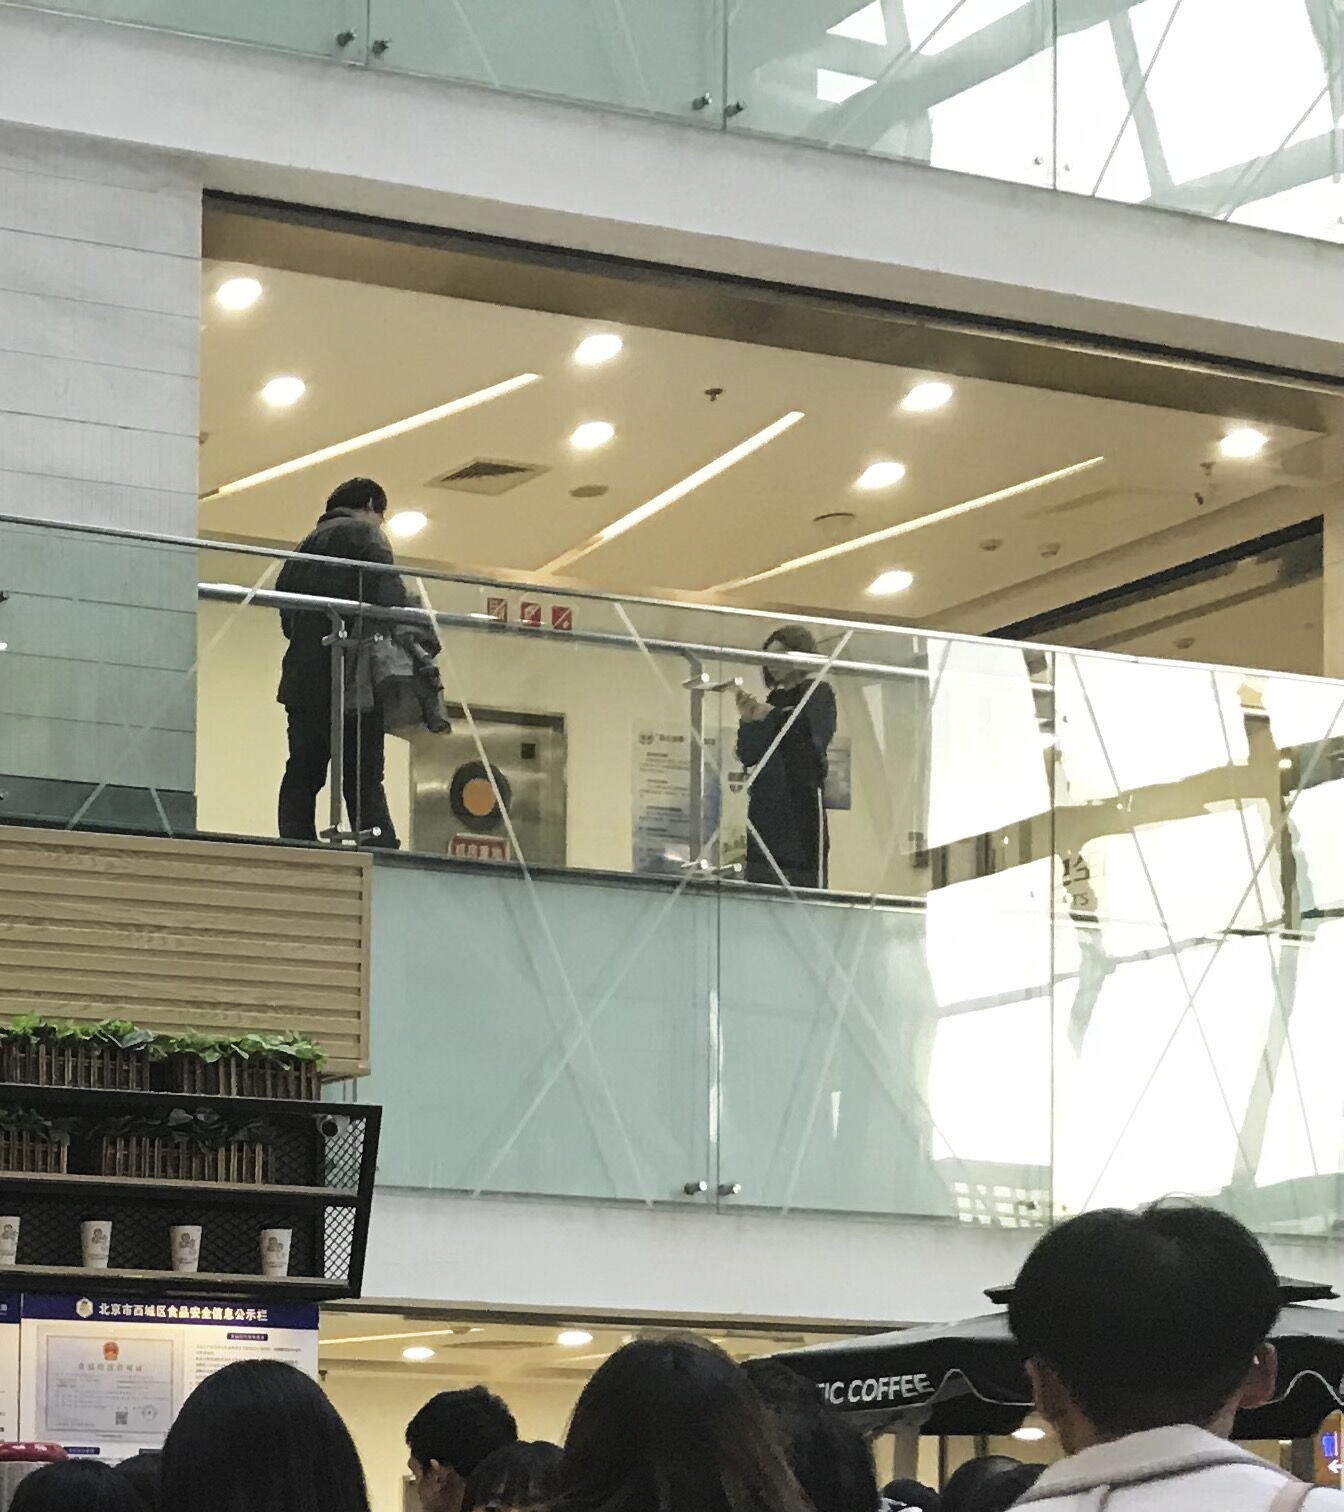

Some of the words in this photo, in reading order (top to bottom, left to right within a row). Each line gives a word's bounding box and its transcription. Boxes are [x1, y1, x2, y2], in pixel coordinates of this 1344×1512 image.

[98, 1302, 268, 1322] 北京市西城区食品安全信息公示栏
[848, 1374, 936, 1402] COFFEE
